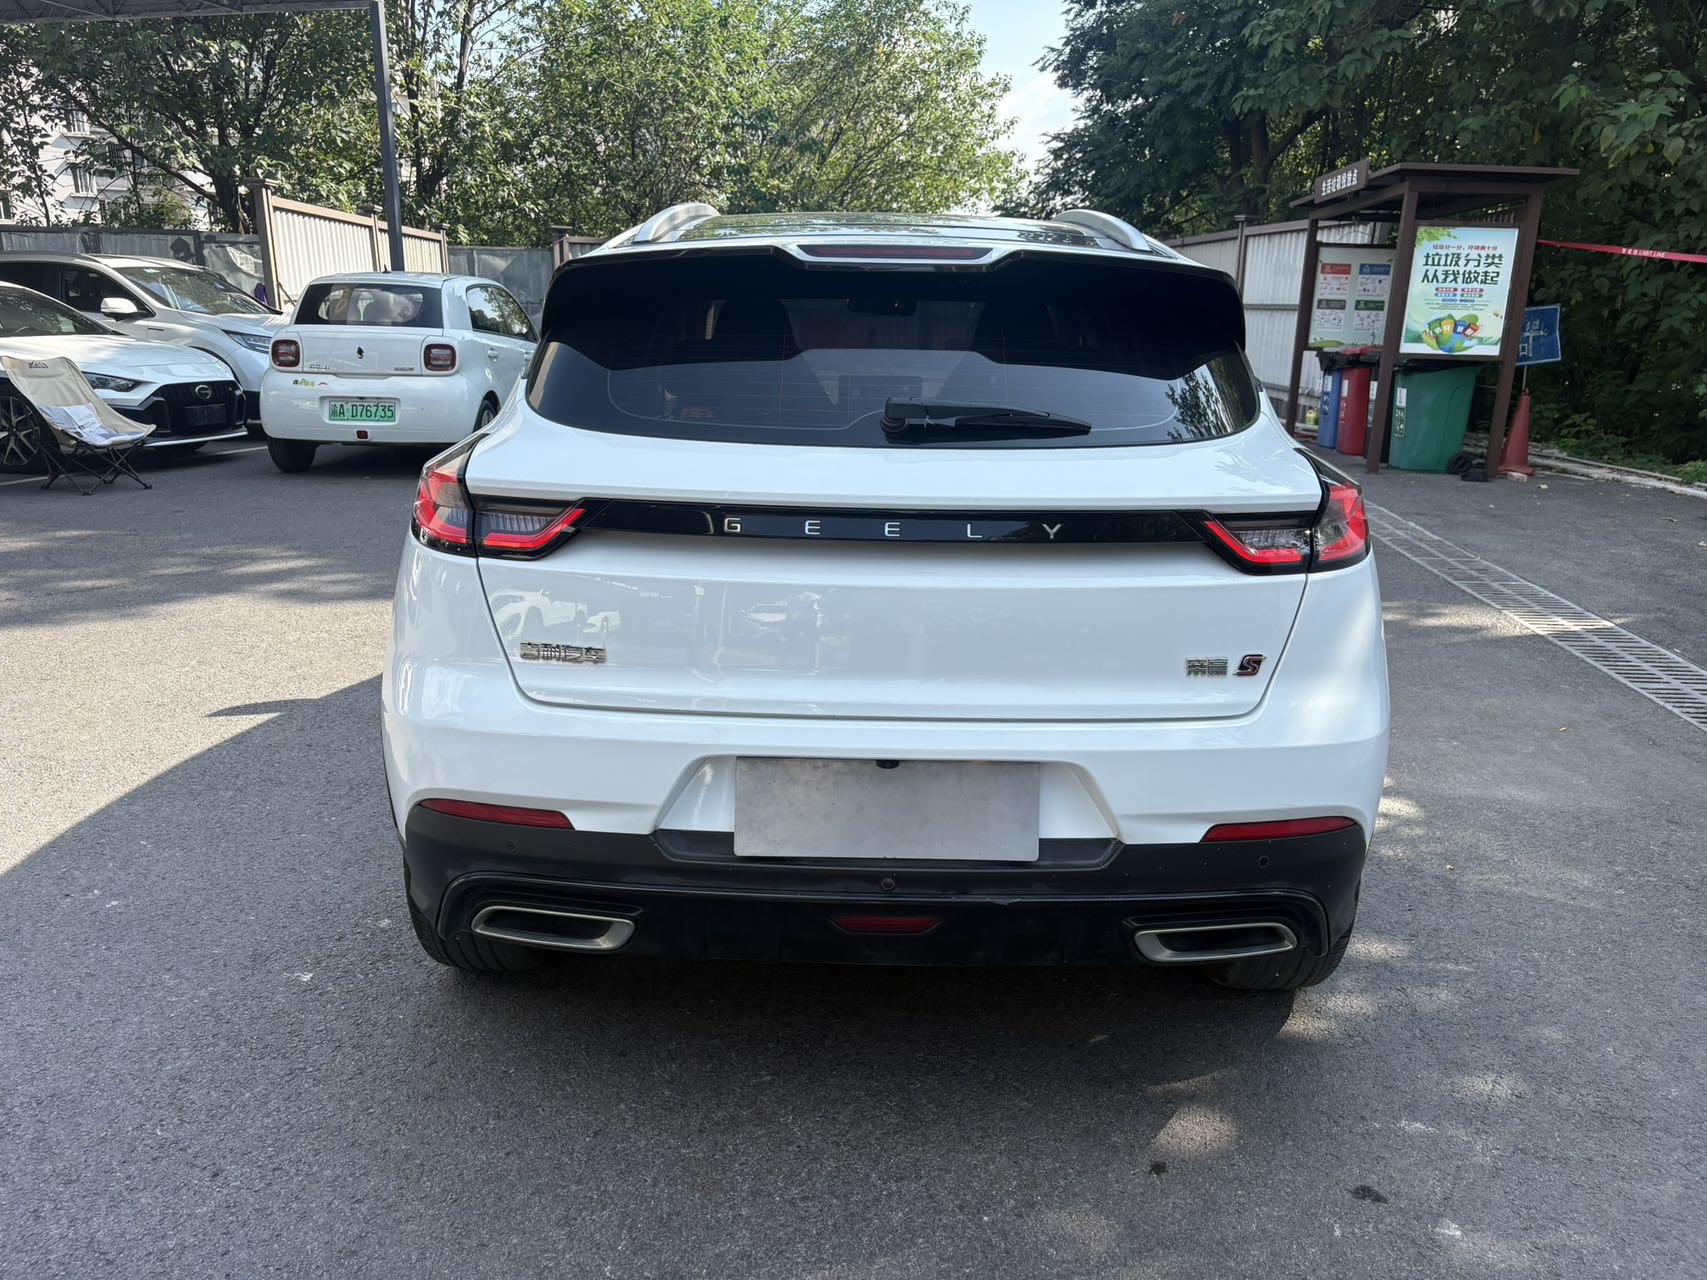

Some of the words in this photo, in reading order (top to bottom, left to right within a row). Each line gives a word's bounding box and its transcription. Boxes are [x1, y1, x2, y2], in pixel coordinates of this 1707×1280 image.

[1423, 252, 1504, 268] 垃圾分类
[1421, 269, 1499, 285] 从我做起
[723, 516, 1062, 540] GEELY
[520, 642, 607, 664] 吉利汽车
[1233, 654, 1267, 676] S
